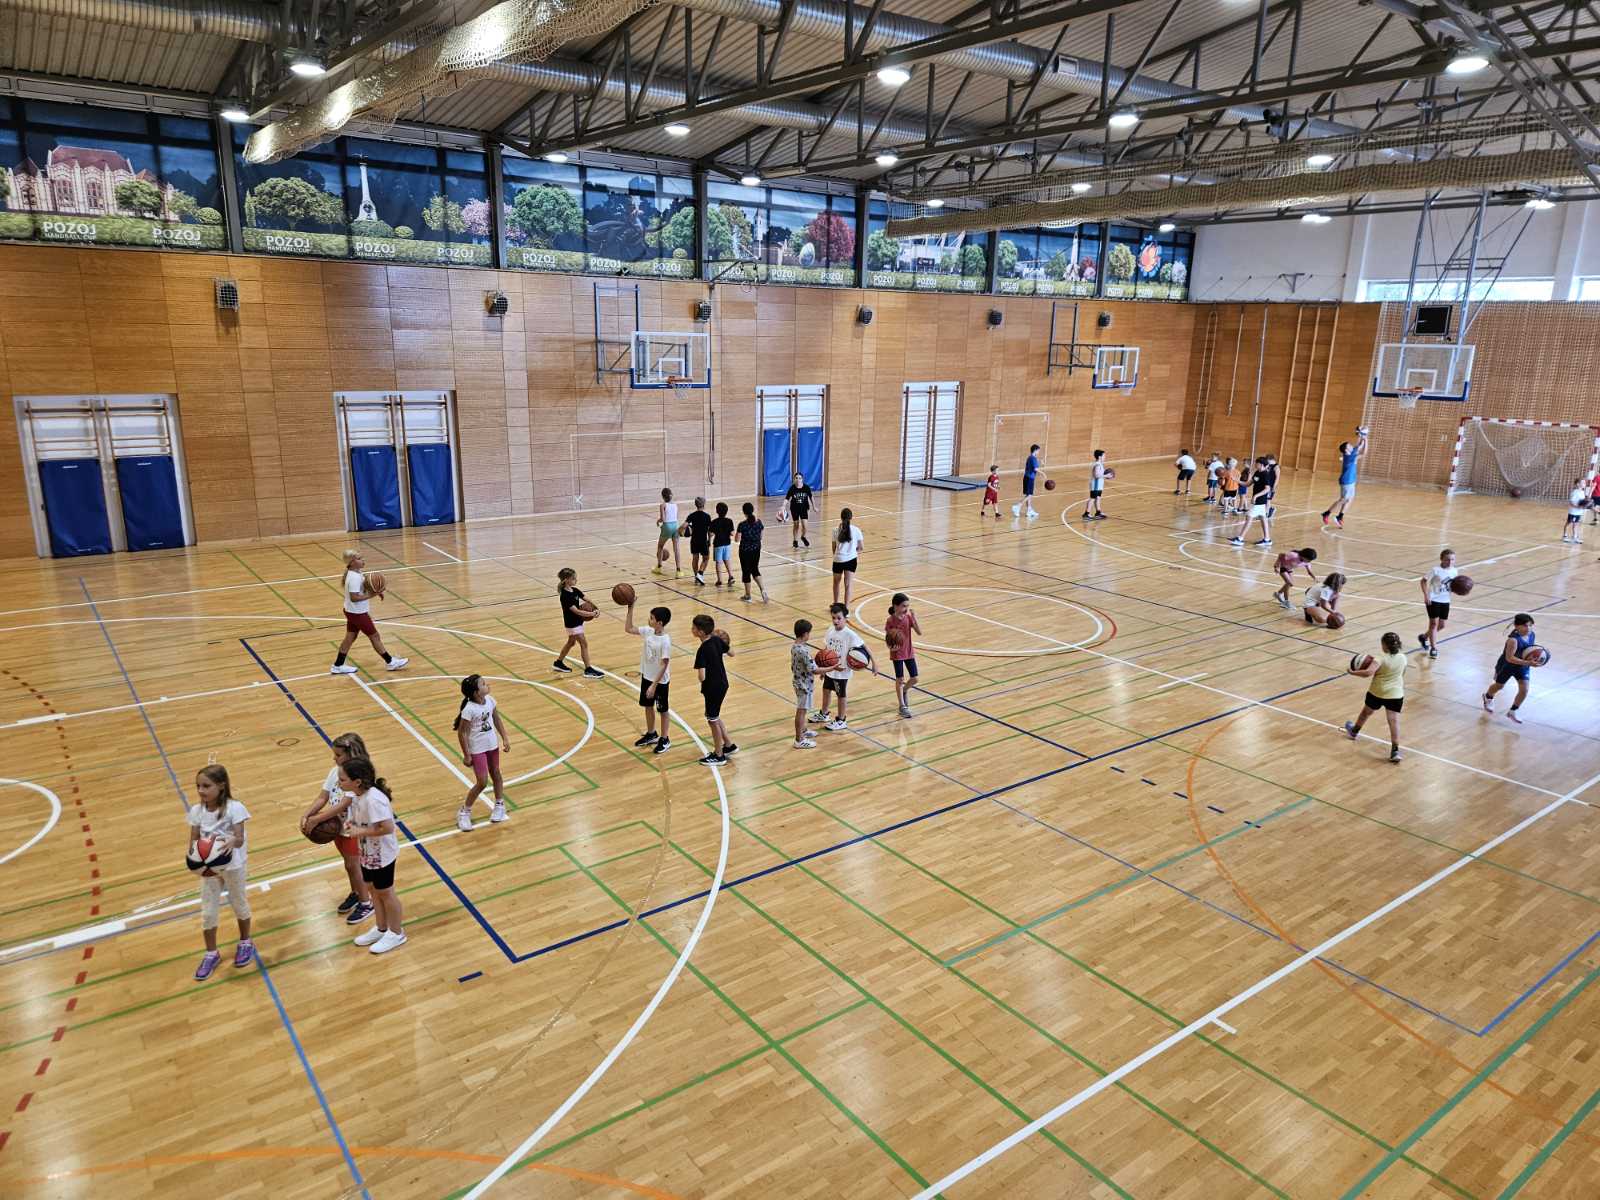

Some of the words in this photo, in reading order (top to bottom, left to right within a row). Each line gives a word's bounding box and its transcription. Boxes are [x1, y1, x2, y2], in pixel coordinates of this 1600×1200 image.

[43, 222, 96, 235] POZOJ
[153, 228, 200, 241] POZOJ
[265, 236, 310, 248] POZOJ
[355, 242, 396, 254] POZOJ
[437, 247, 474, 258] POZOJ
[522, 253, 555, 264] POZOJ
[590, 257, 621, 268] POZOJ
[654, 263, 681, 273] POZOJ
[771, 269, 795, 278] POZOJ
[821, 272, 844, 281] POZOJ
